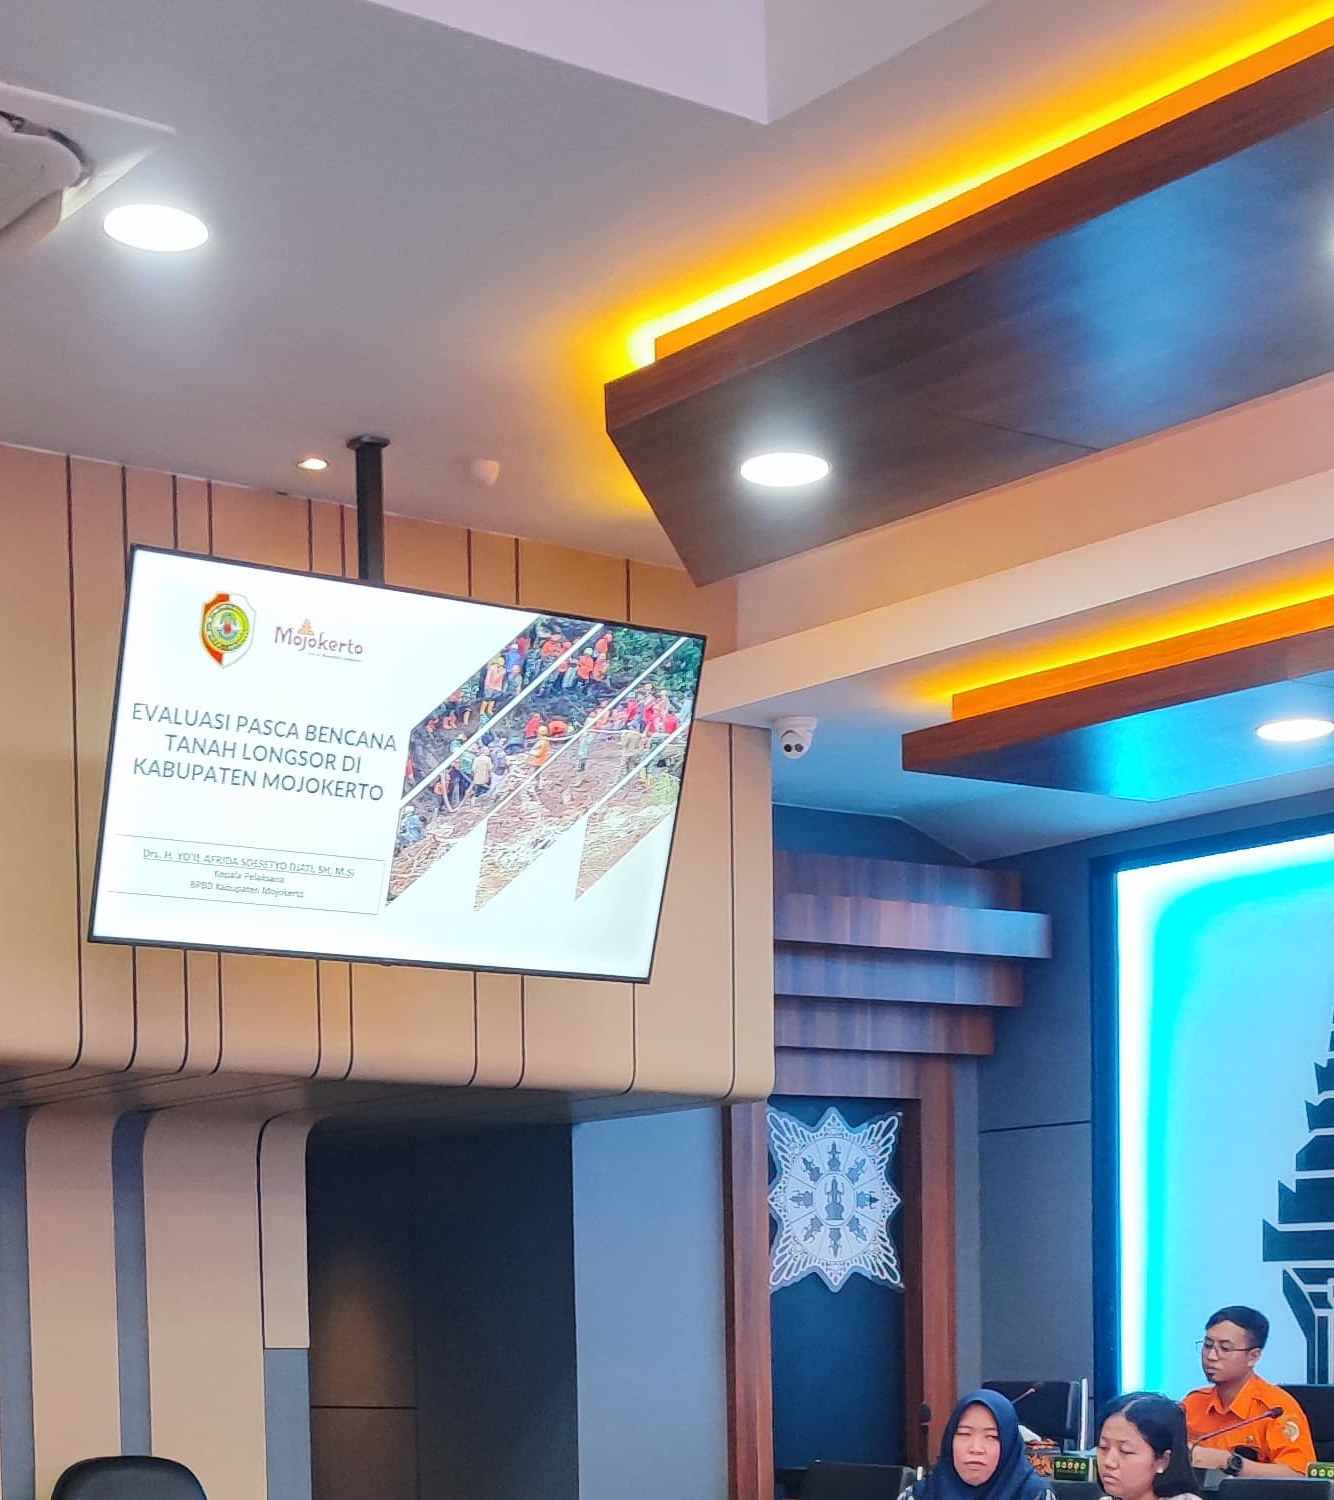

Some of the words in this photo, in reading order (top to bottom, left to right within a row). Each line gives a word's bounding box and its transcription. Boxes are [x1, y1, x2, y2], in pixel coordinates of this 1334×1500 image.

[274, 625, 364, 655] Mojokerto
[132, 702, 230, 731] EVALUASI
[236, 715, 299, 739] PASCA
[305, 724, 397, 751] BENCANA
[165, 734, 236, 758] TANAH
[242, 742, 336, 770] LONGSOR
[342, 755, 362, 773] DI
[132, 757, 257, 787] KABUPATEN
[262, 771, 384, 801] MOJOKERTO
